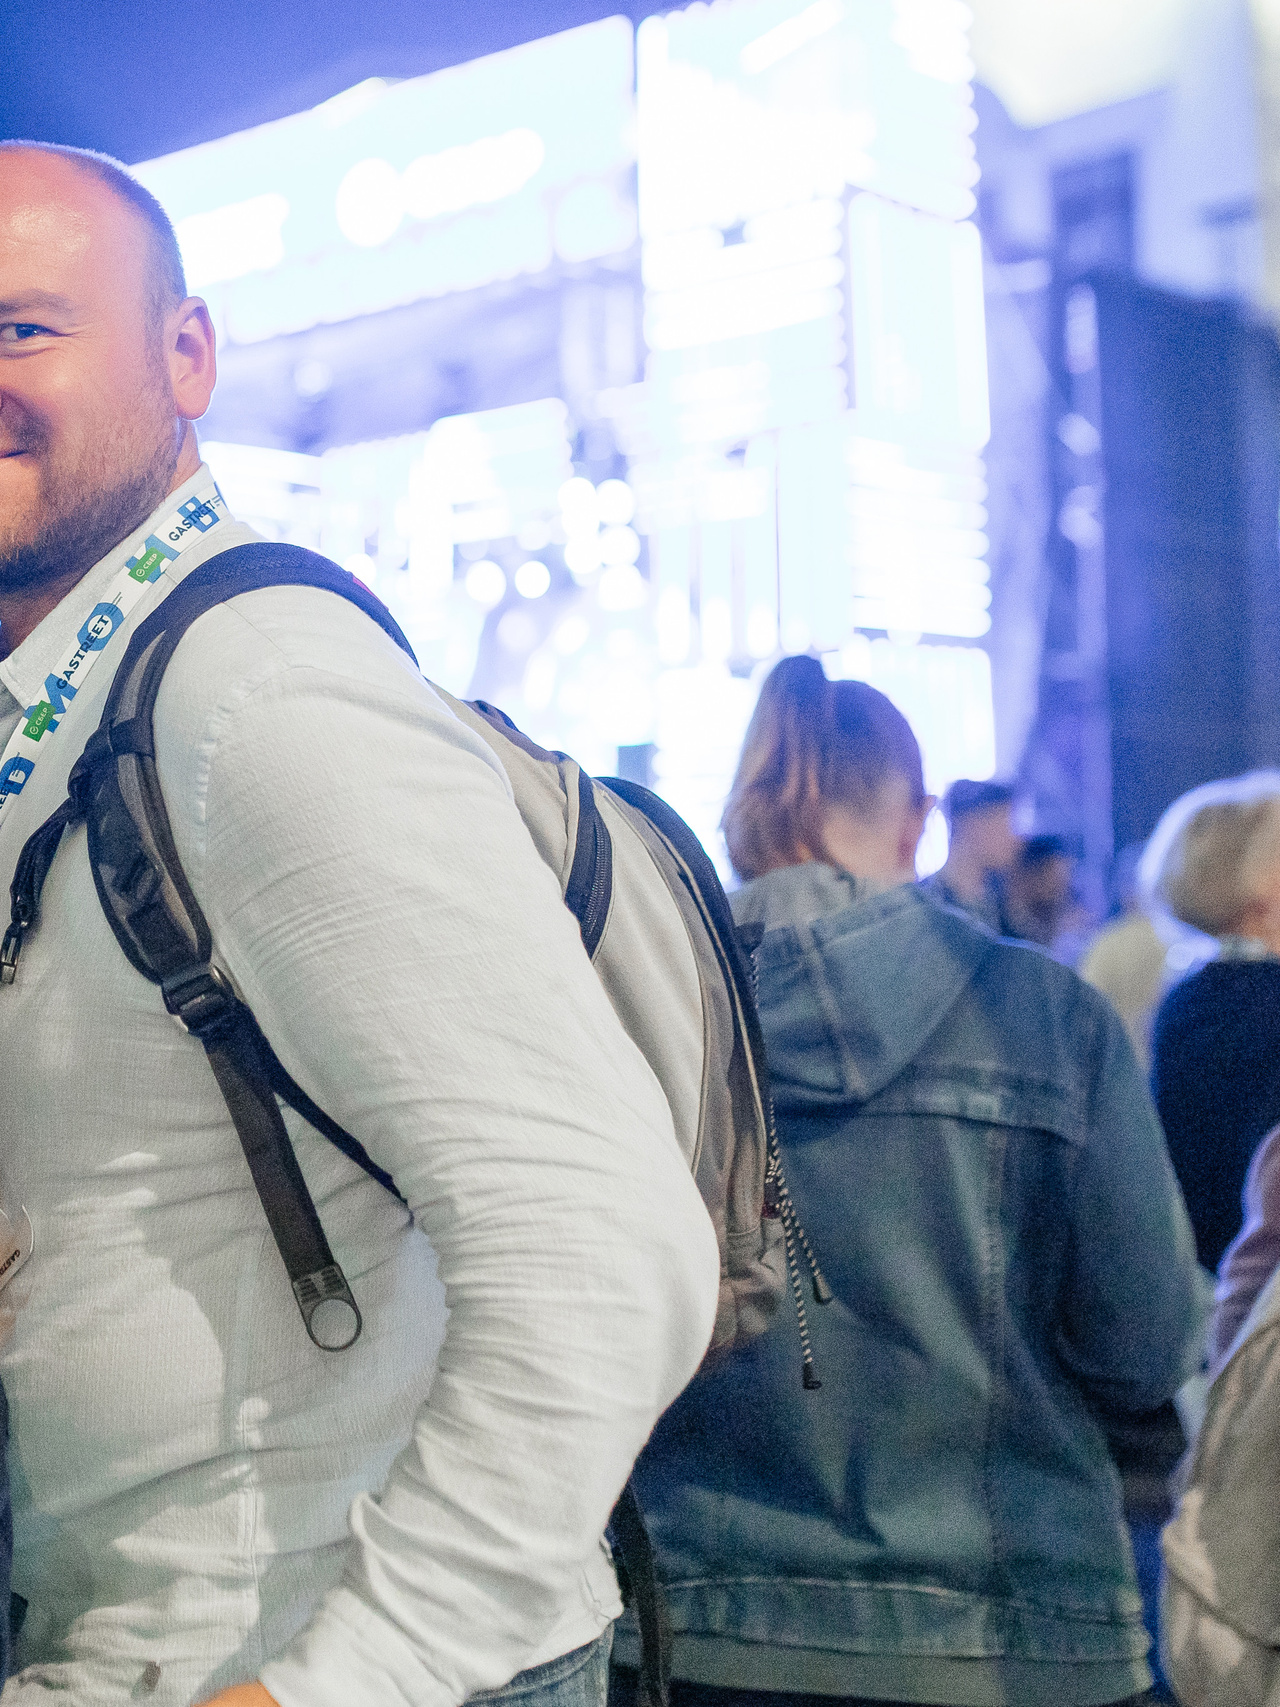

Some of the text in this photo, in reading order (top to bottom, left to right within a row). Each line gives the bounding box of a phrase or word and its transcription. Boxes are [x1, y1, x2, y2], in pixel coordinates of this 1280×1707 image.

[168, 499, 216, 542] GASTREET
[142, 553, 158, 570] СБЕР
[56, 615, 110, 690] GASTREET
[35, 707, 48, 726] СБЕР
